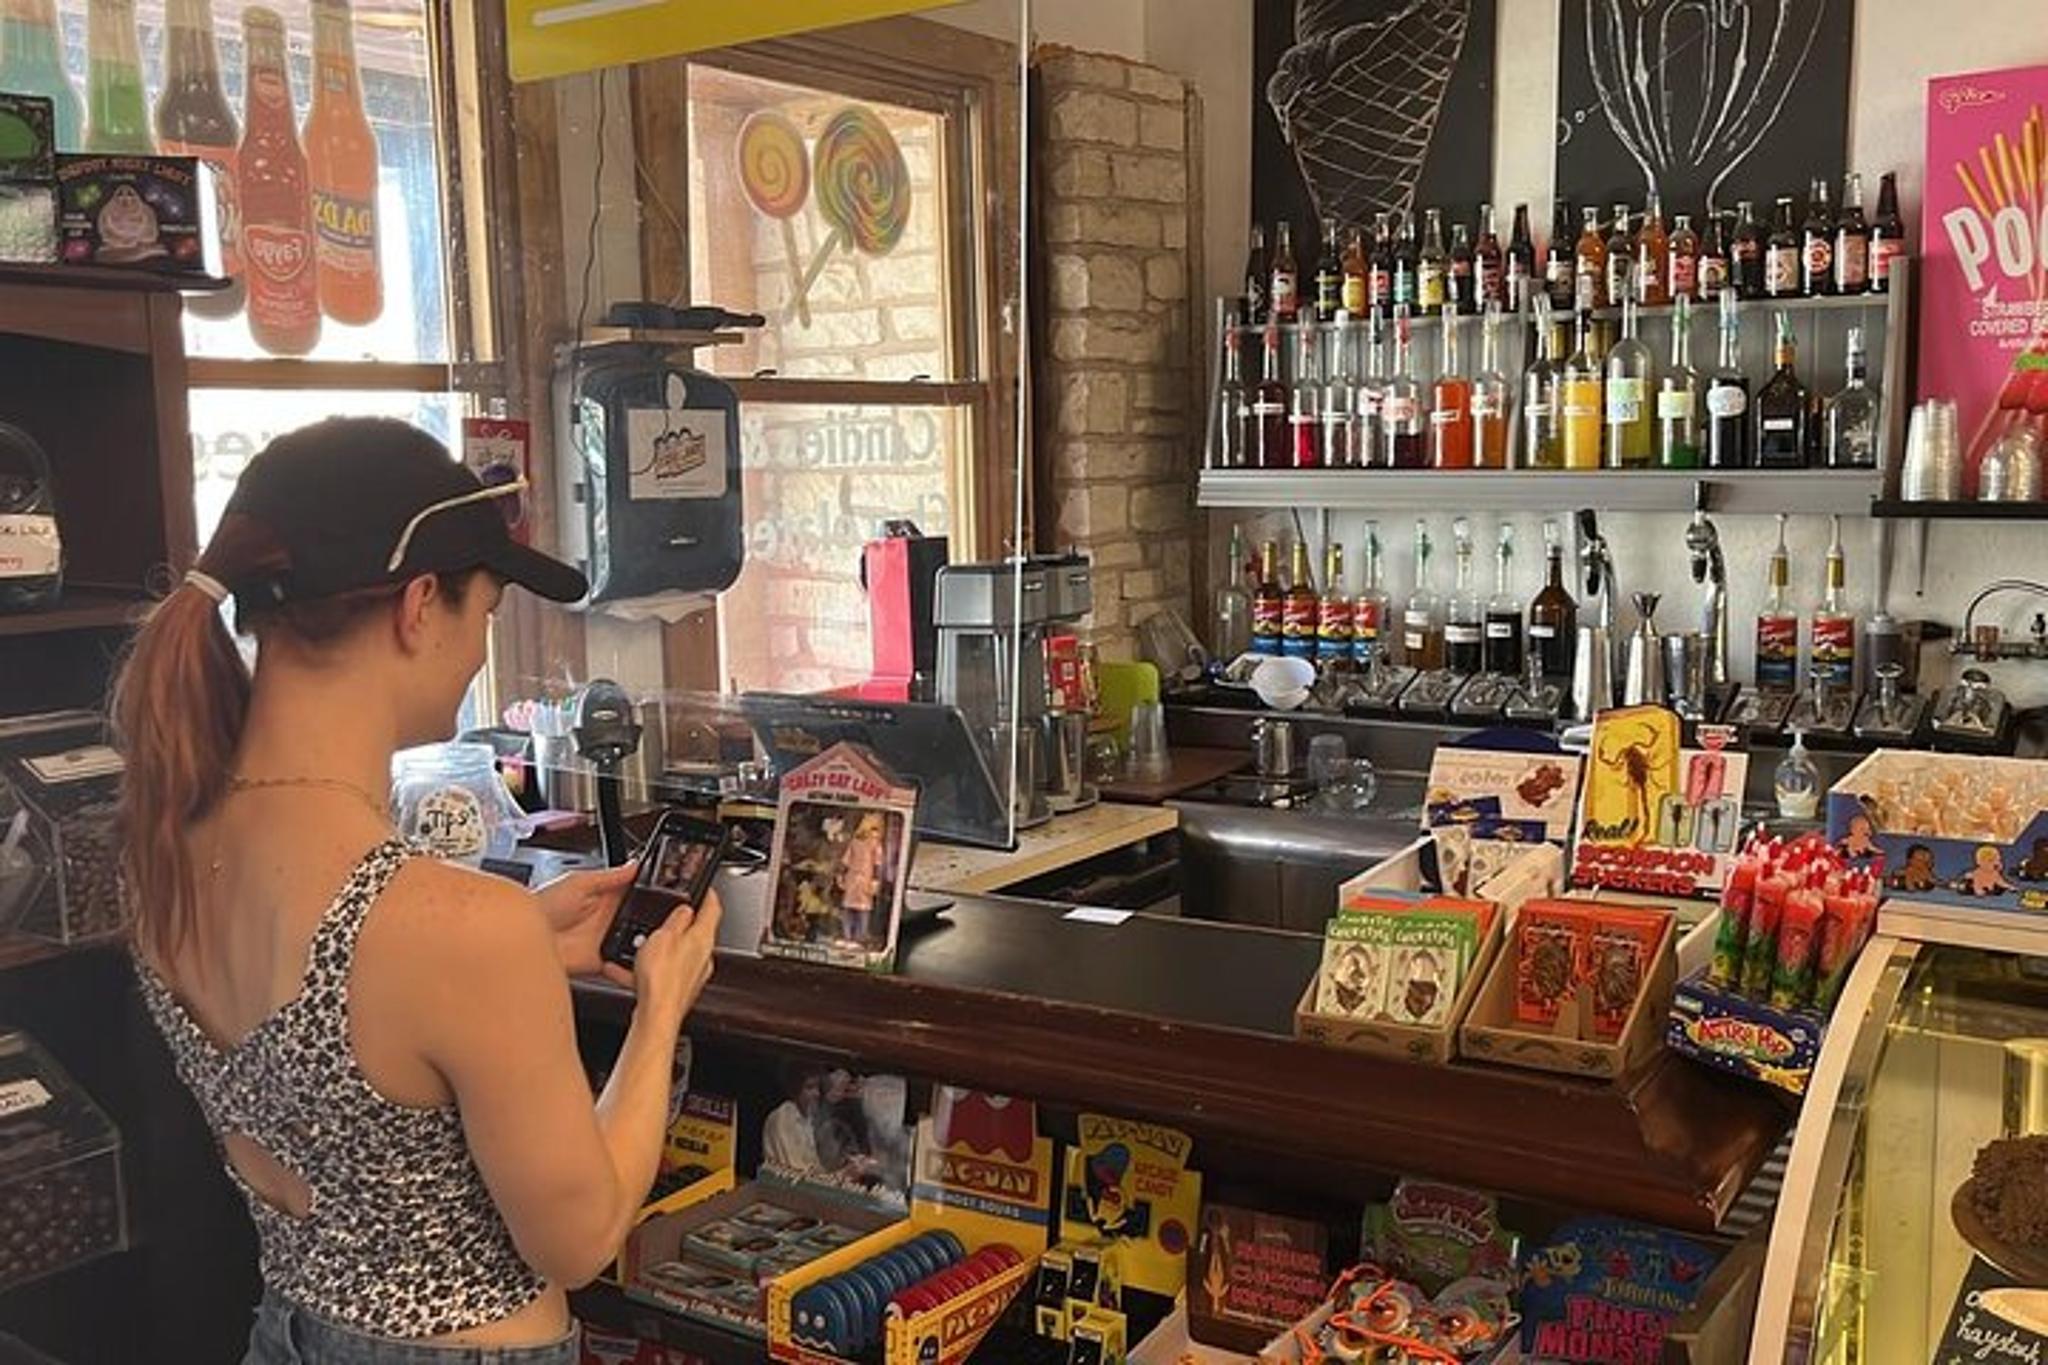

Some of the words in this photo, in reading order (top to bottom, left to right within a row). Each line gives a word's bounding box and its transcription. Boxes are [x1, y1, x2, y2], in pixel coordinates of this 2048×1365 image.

[1942, 206, 2048, 292] PO
[1576, 844, 1715, 876] SCORPION
[1572, 864, 1697, 894] SUCKERS
